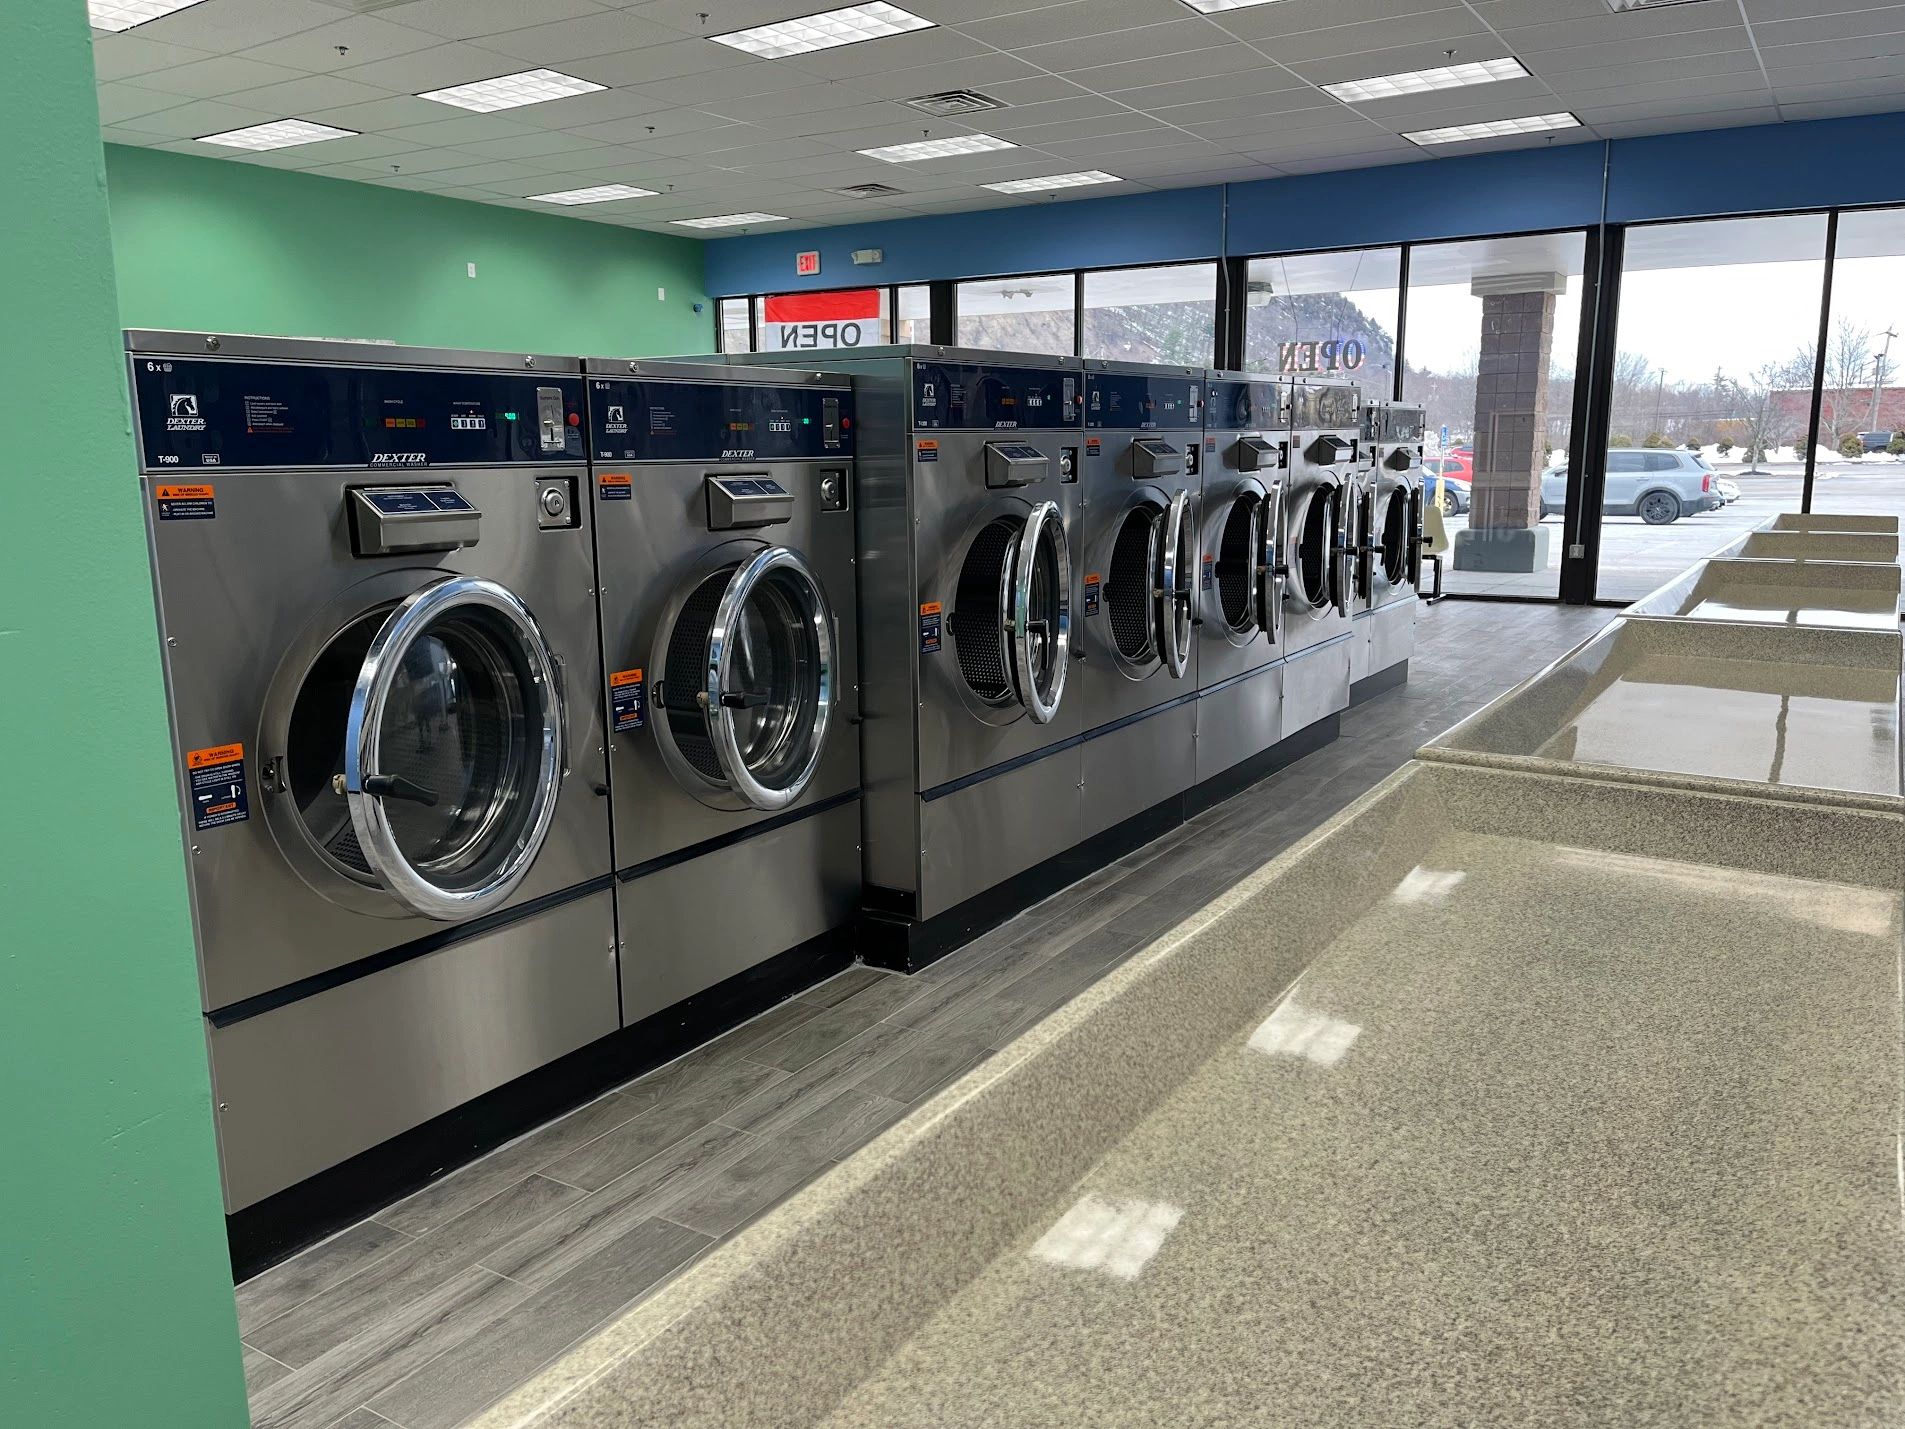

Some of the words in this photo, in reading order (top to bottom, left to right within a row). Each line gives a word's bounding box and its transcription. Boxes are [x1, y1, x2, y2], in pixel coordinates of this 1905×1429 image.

[800, 254, 816, 272] EXIT
[147, 361, 154, 372] 6
[995, 420, 1017, 428] DEXTER
[371, 453, 426, 463] DEXTER
[721, 450, 754, 458] DEXTER
[158, 455, 179, 464] T-900
[208, 748, 234, 758] WARNING
